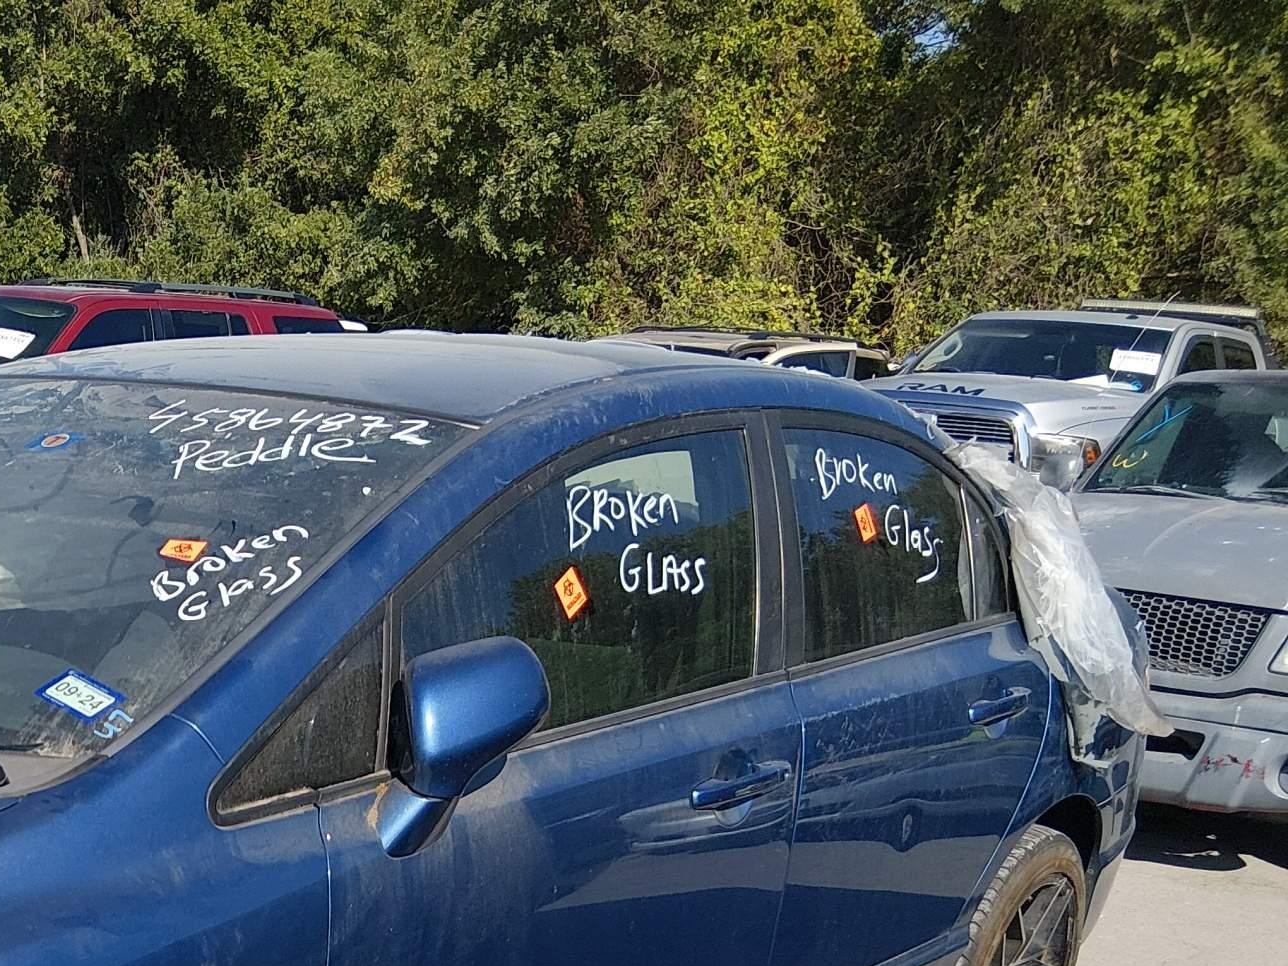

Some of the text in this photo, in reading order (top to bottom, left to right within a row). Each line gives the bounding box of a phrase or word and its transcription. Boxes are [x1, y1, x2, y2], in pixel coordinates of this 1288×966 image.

[896, 382, 986, 396] RAM
[148, 399, 432, 446] 45864872
[171, 432, 377, 481] Peddle
[54, 681, 104, 711] 09 24
